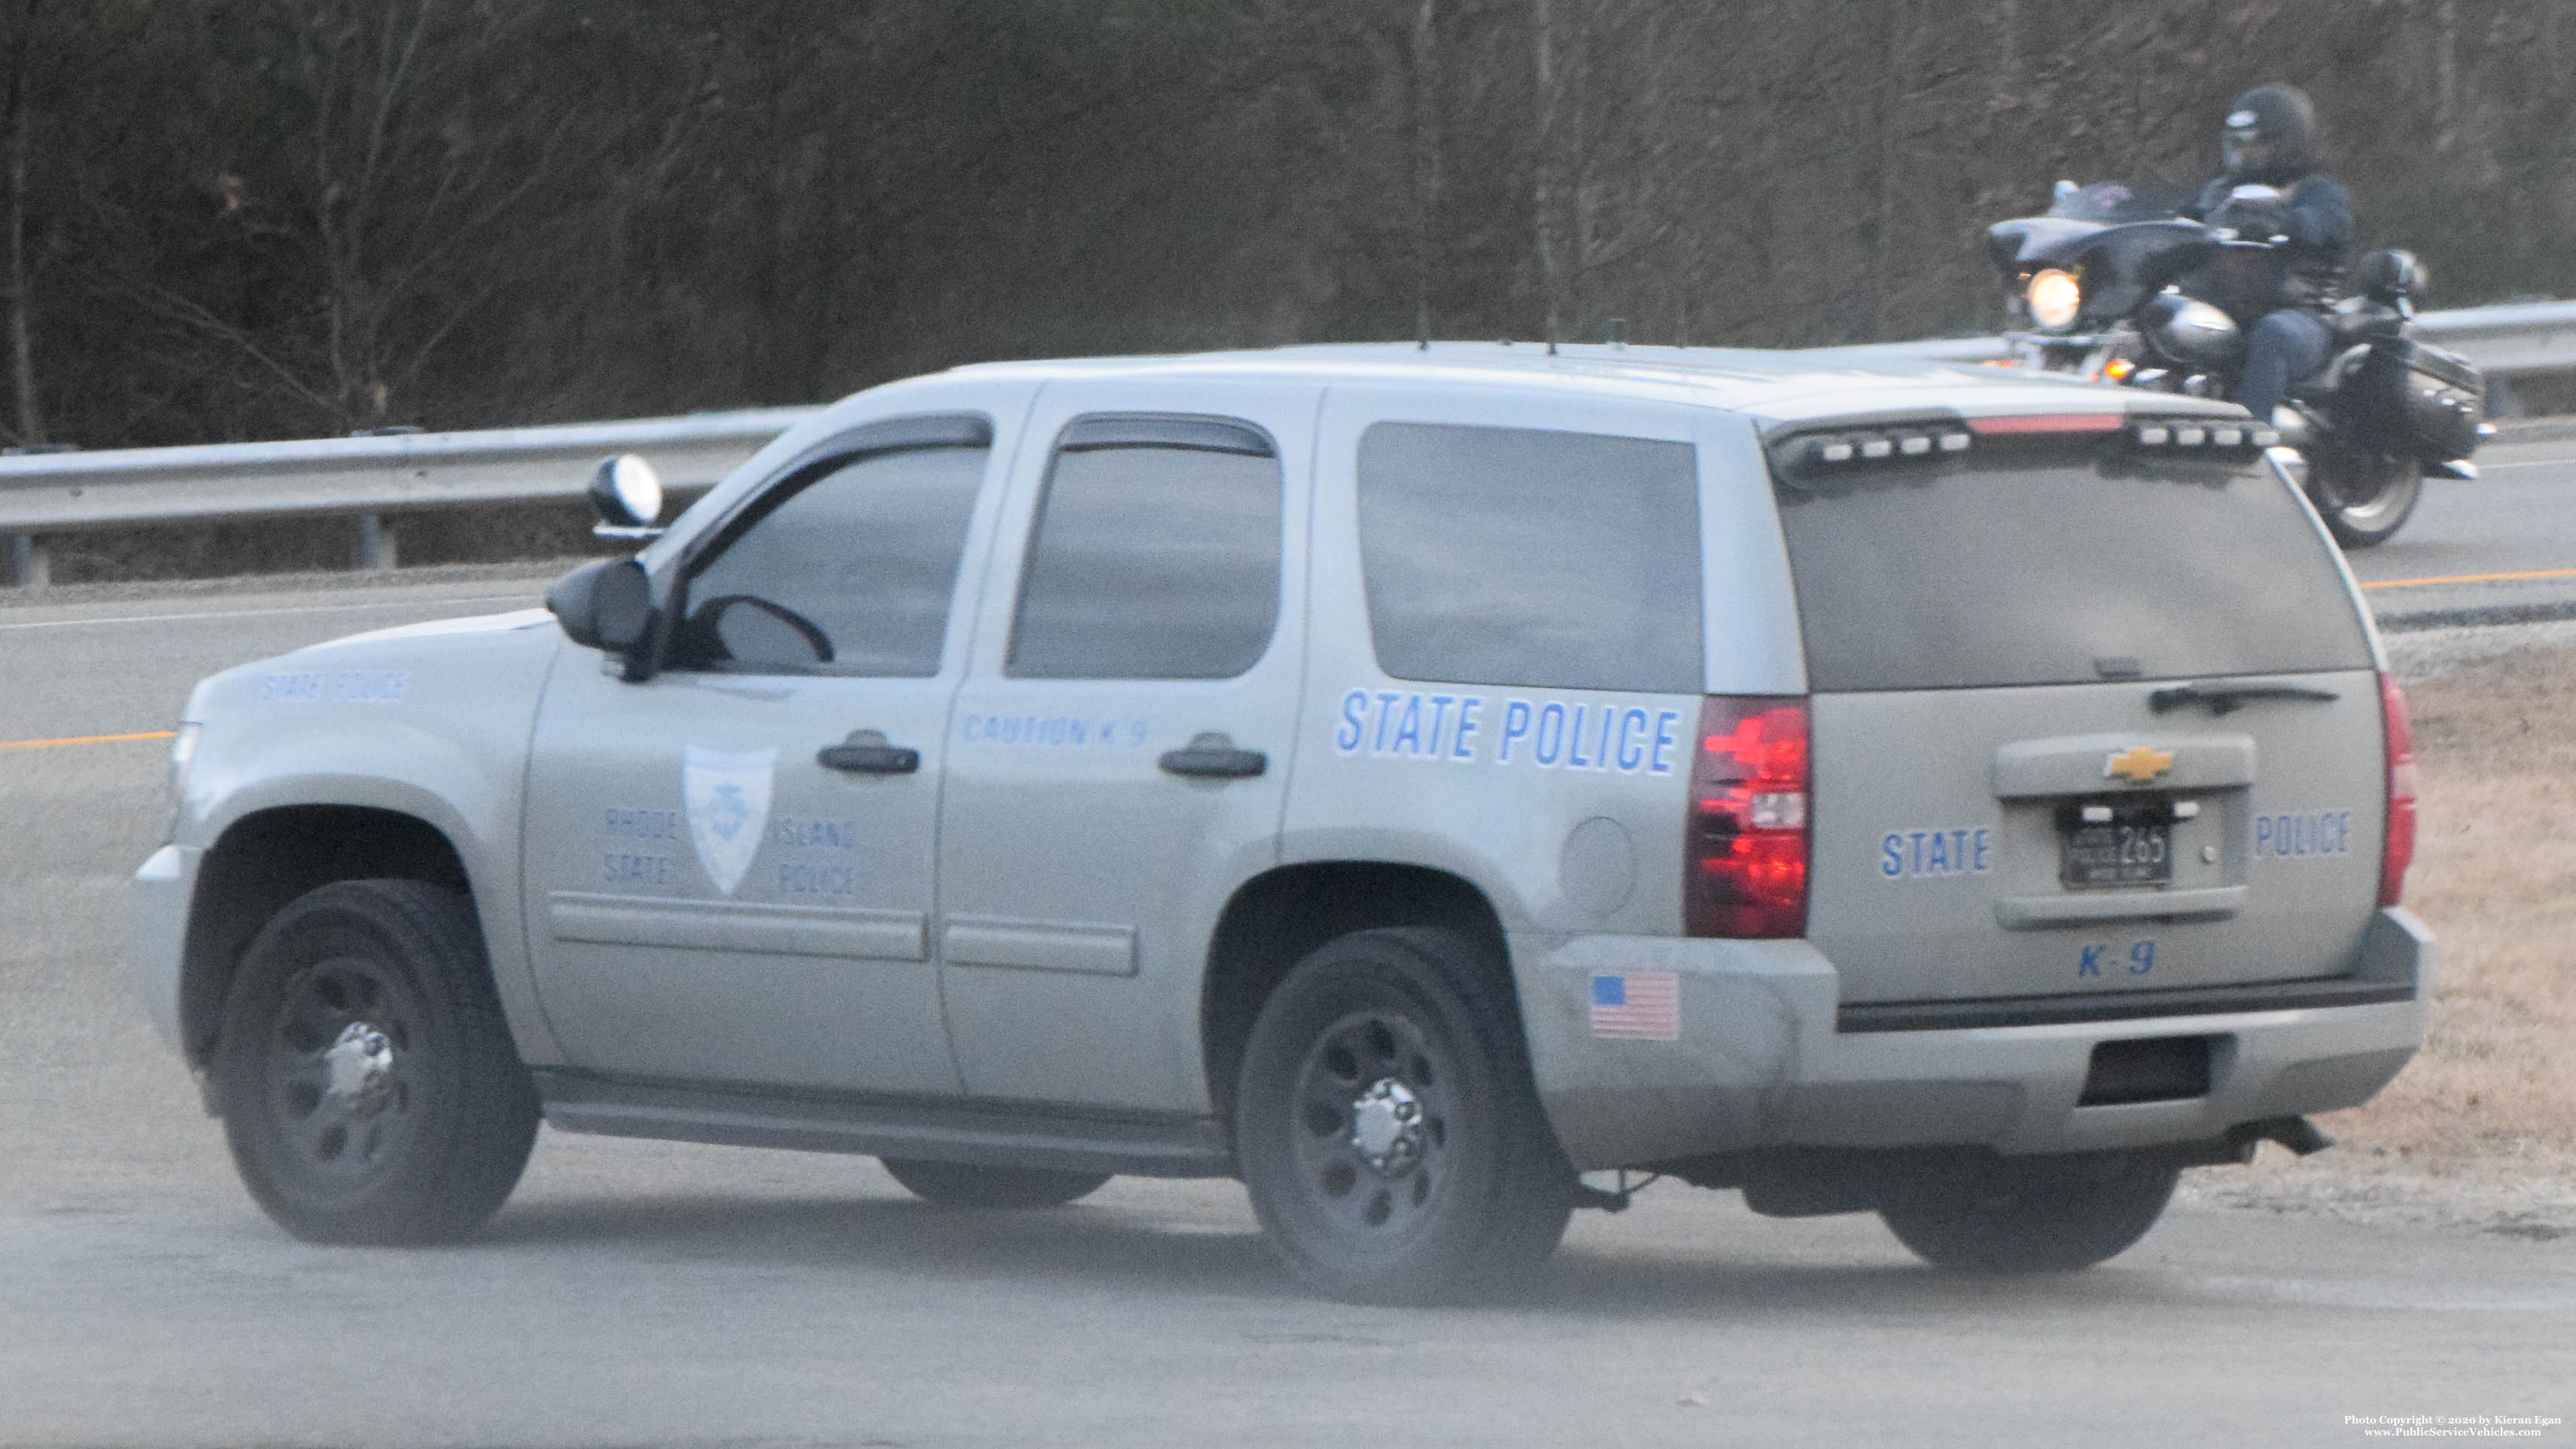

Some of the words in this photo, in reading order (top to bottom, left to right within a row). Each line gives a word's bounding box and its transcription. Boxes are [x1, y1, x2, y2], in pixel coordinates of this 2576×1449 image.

[964, 714, 1089, 745] CAUTION
[1338, 690, 1483, 759] STATE
[1500, 700, 1680, 775] POLICE
[605, 808, 677, 840] RHODE
[1882, 828, 1991, 876] STATE
[2256, 811, 2352, 857] POLICE
[2119, 825, 2166, 864] 265
[604, 852, 671, 884] STATE
[779, 863, 854, 895] POLICE
[2078, 940, 2157, 978] K-9
